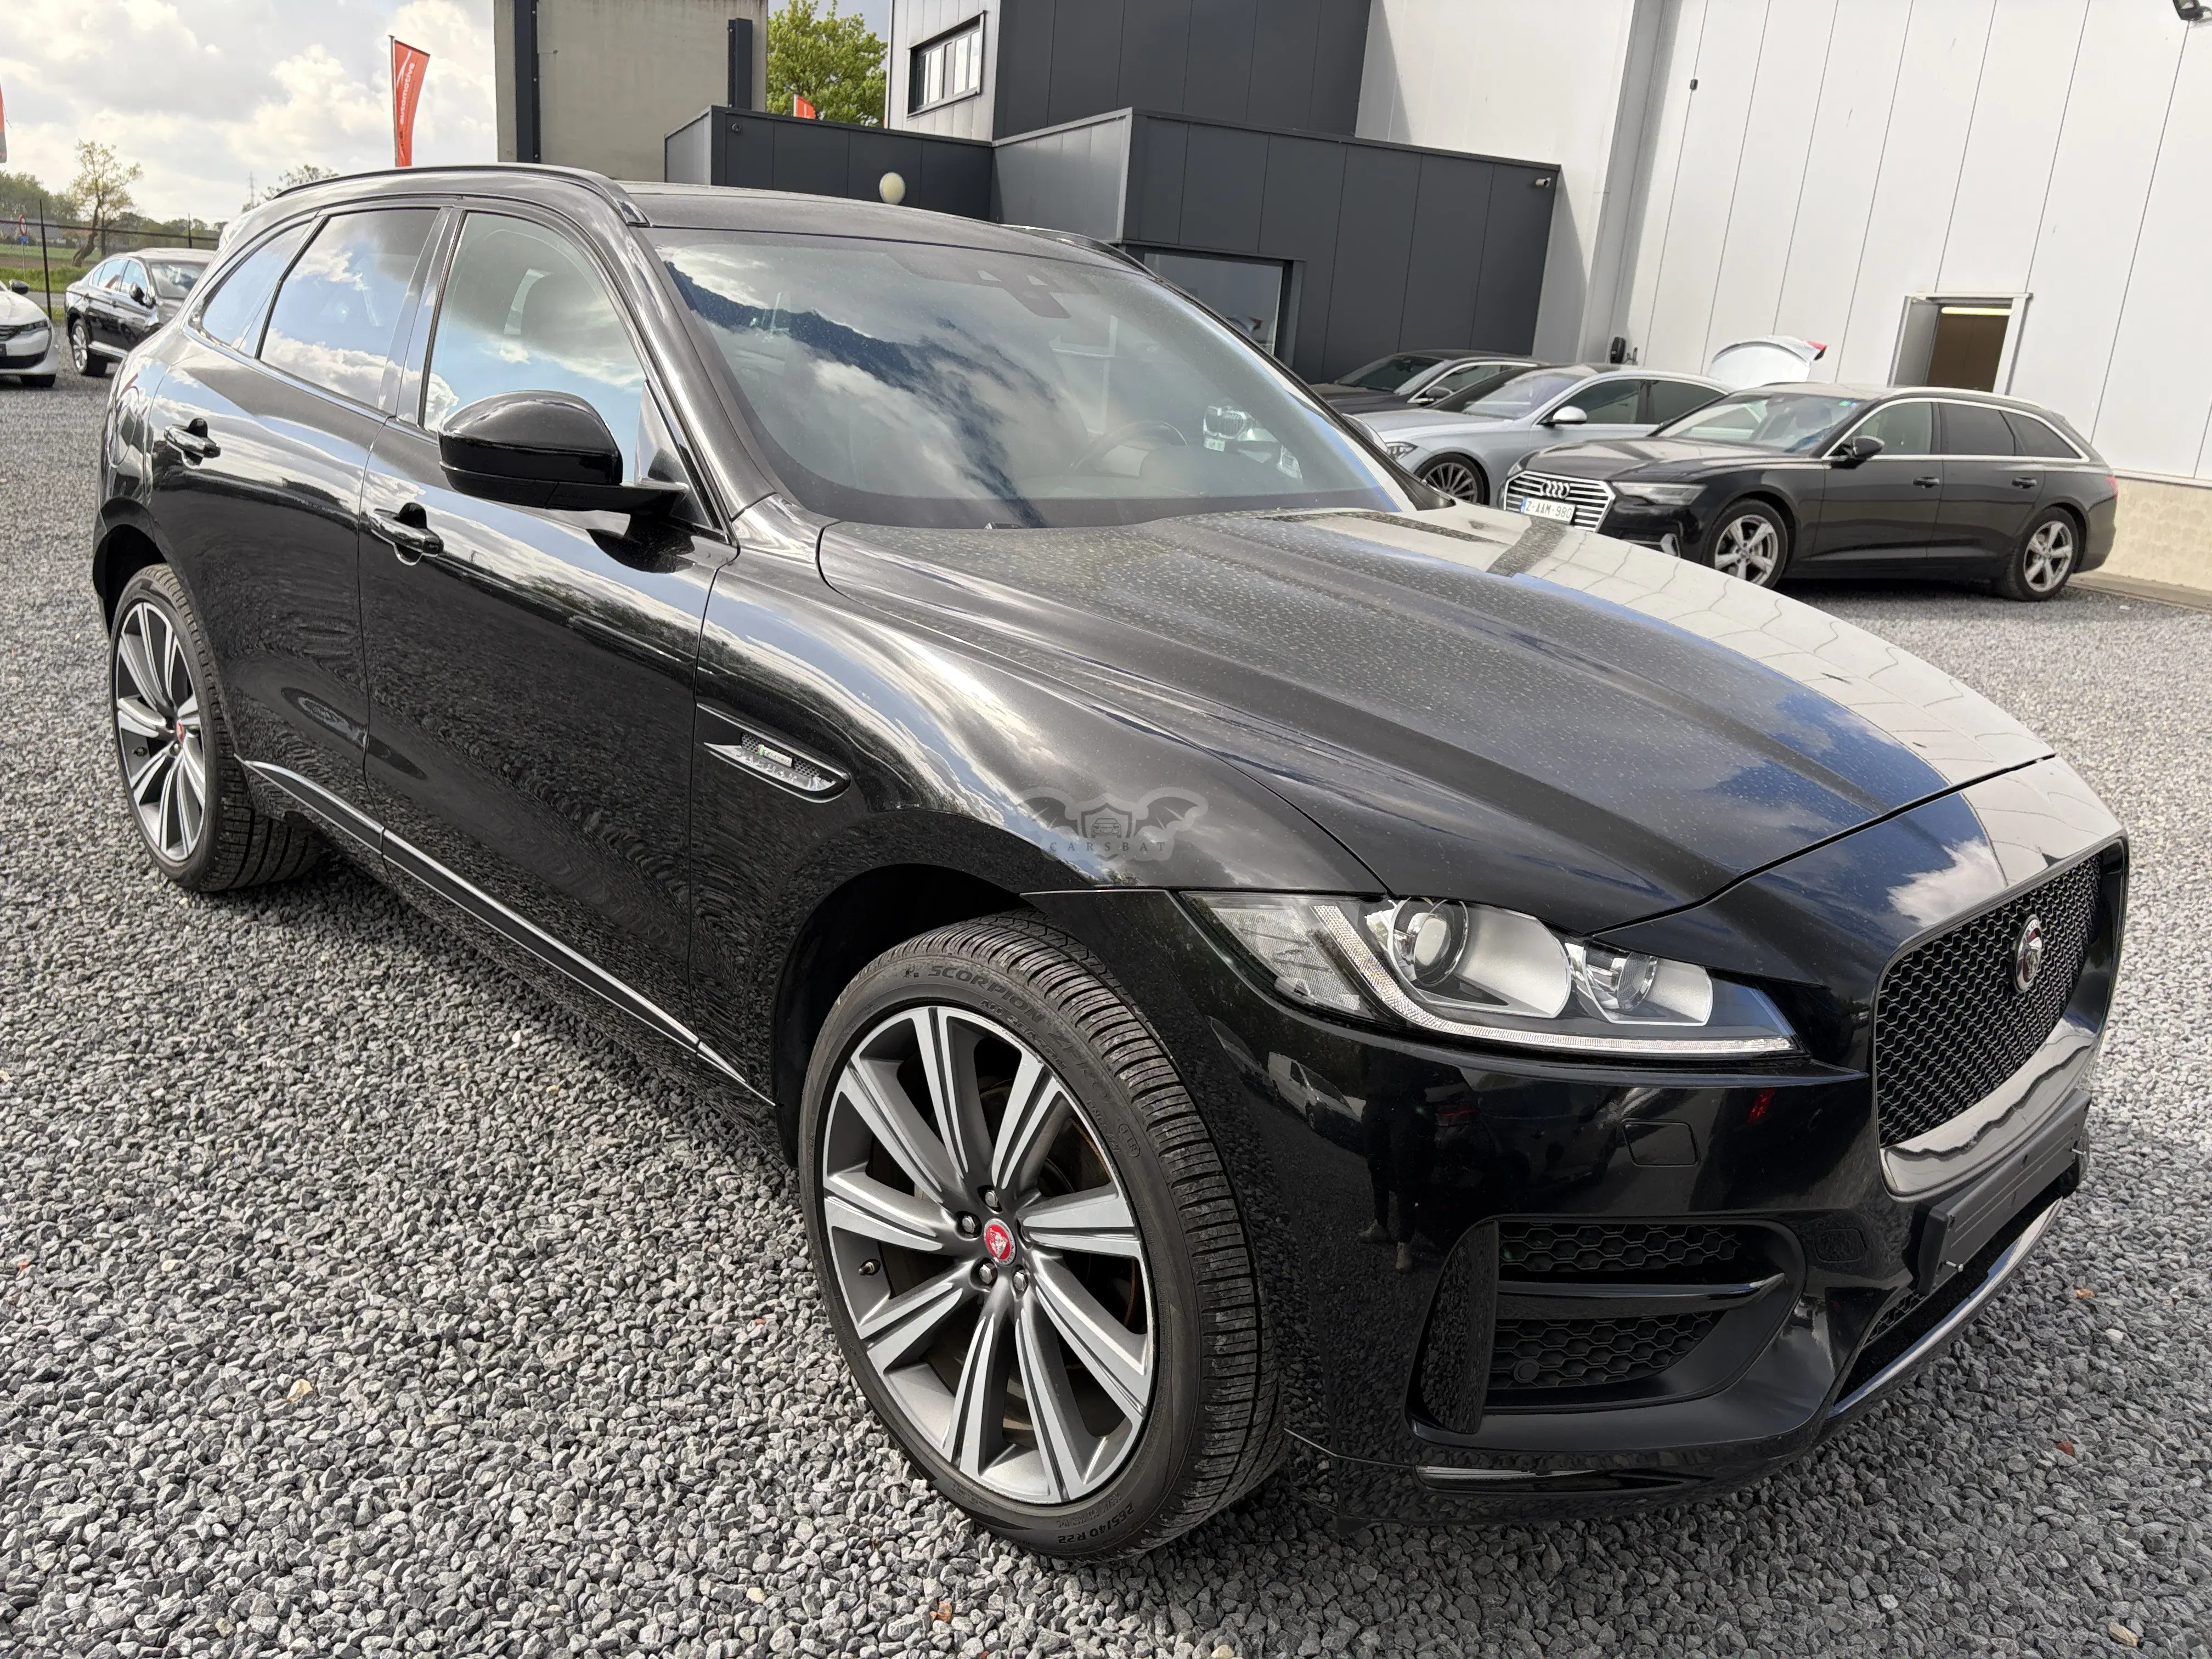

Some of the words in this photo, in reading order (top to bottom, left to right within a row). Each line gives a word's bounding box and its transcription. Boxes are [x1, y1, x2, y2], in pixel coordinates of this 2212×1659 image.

[928, 966, 1045, 1023] SCORPION
[1058, 1530, 1087, 1544] R22
[1090, 1502, 1135, 1538] 265/40
